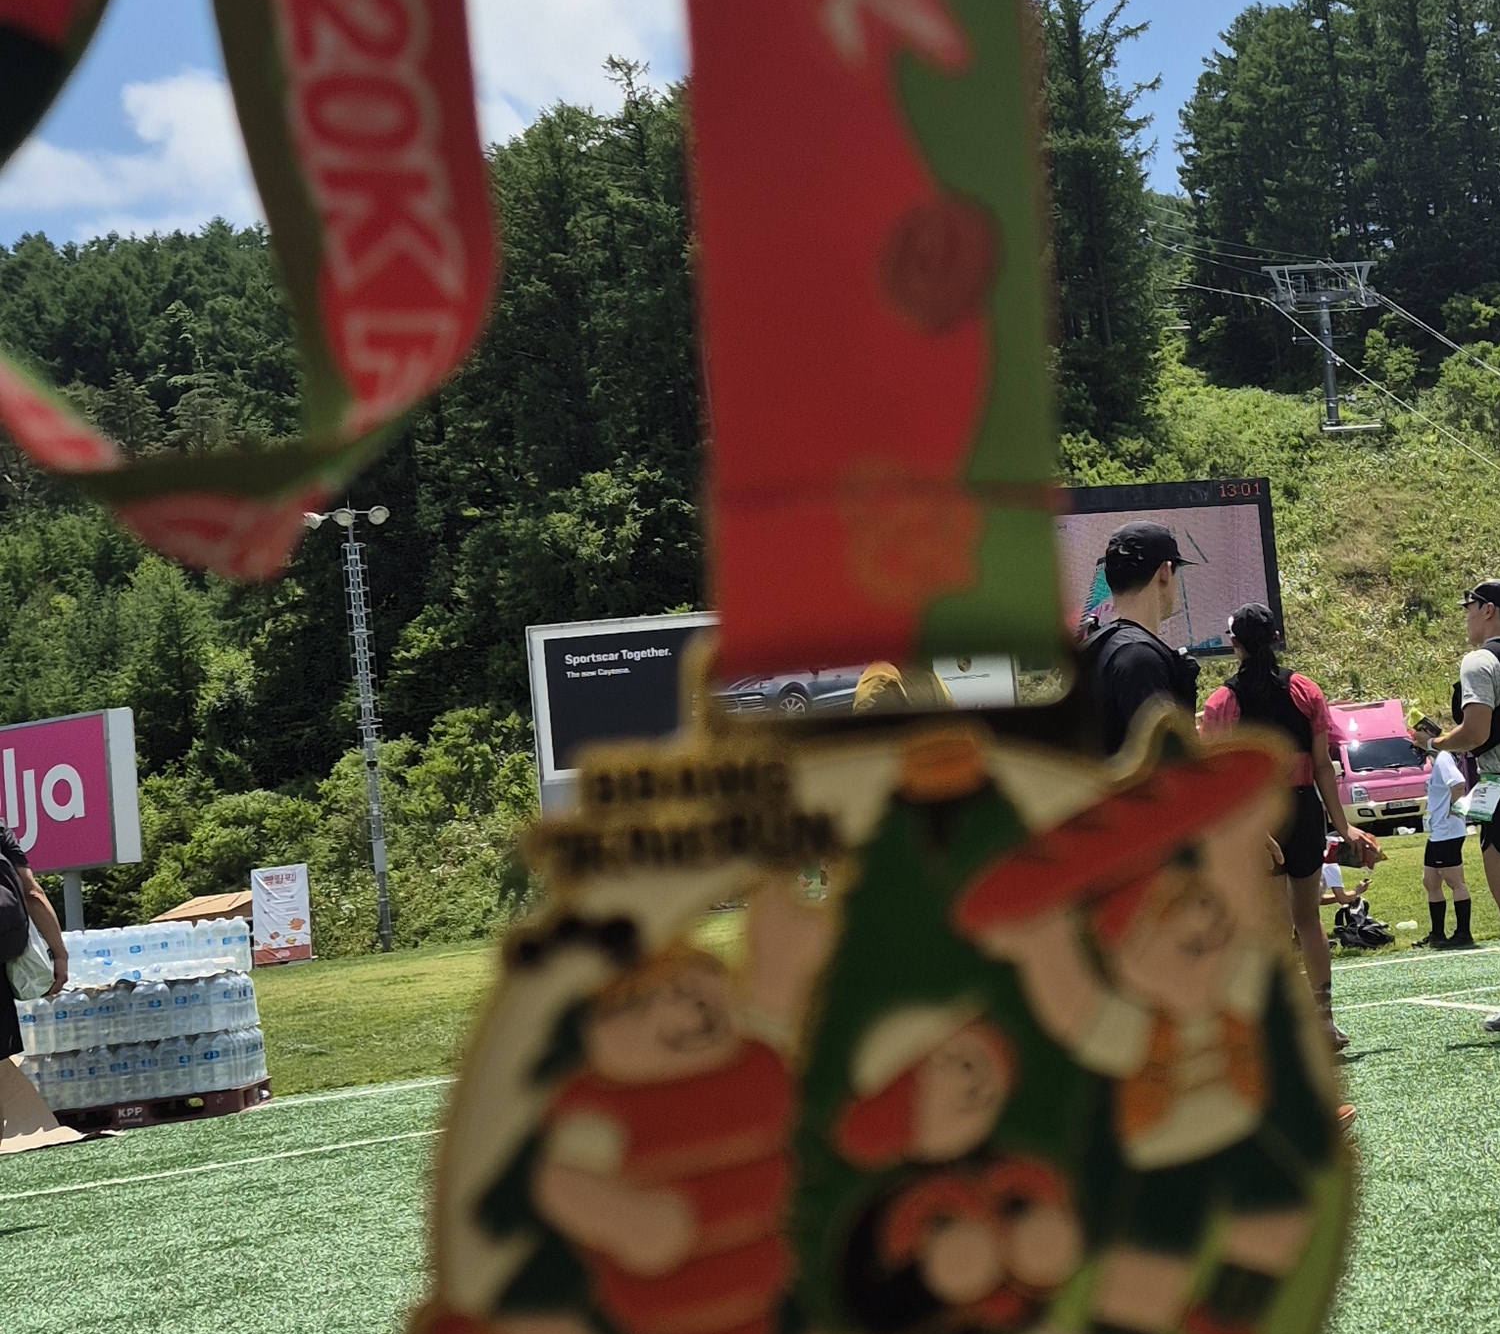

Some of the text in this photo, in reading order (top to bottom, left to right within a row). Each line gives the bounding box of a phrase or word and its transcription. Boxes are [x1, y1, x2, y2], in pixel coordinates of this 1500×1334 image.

[564, 646, 672, 666] Sportscar Together.
[0, 748, 86, 853] lja
[117, 1106, 143, 1118] KPP
